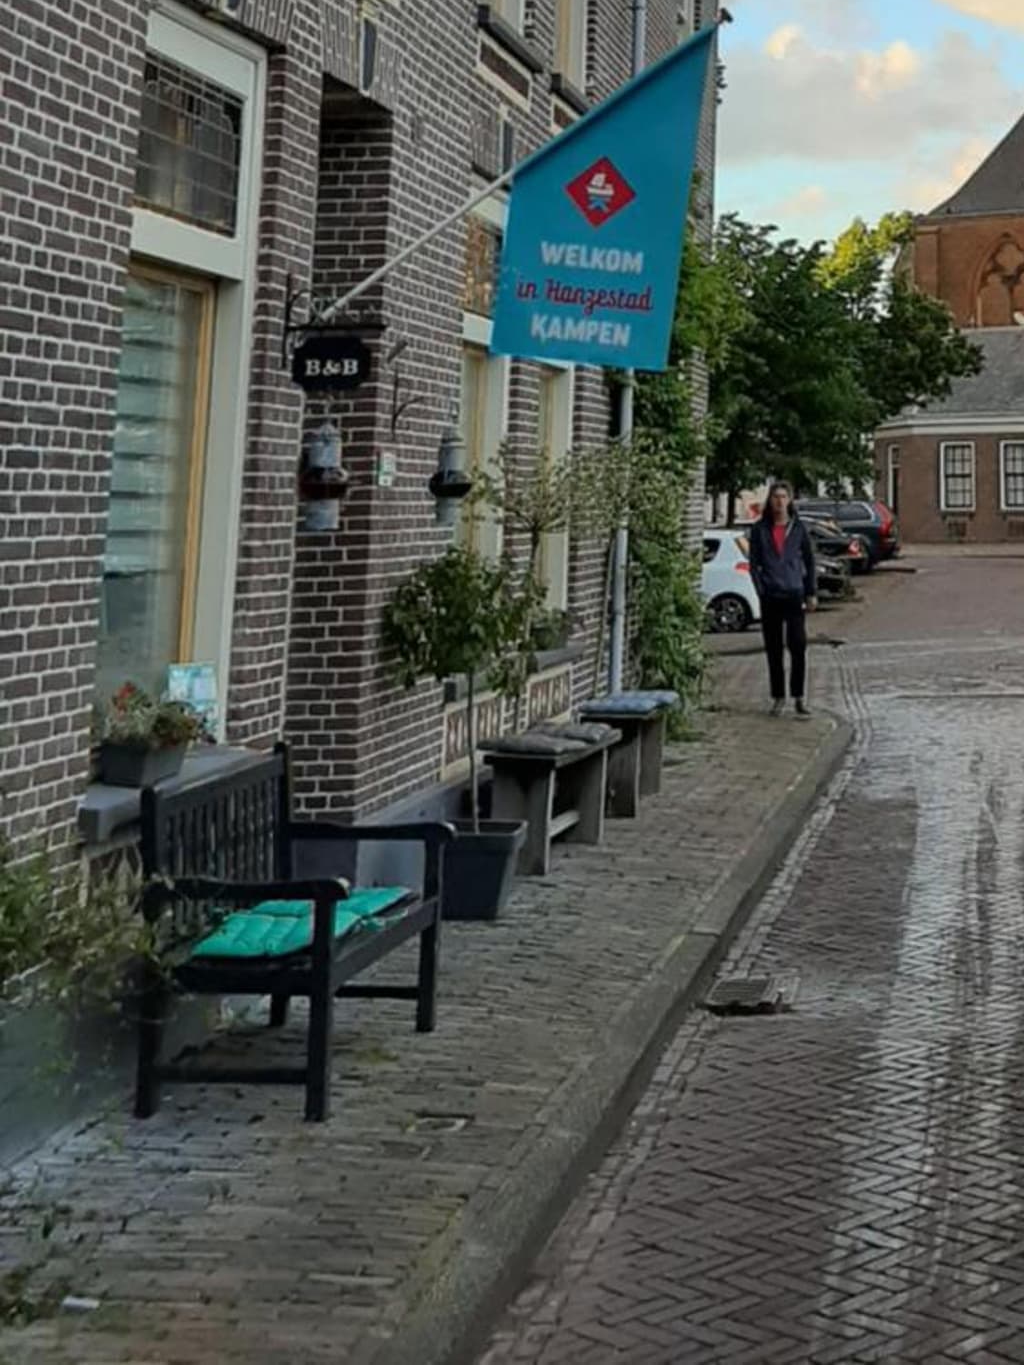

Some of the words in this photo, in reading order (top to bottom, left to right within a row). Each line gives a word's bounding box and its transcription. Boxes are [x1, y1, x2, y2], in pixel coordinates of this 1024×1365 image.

[541, 240, 644, 275] WELKOM
[516, 277, 538, 299] in
[544, 277, 654, 316] Hanzestad
[530, 313, 631, 347] KAMPEN
[304, 358, 359, 376] B&B
